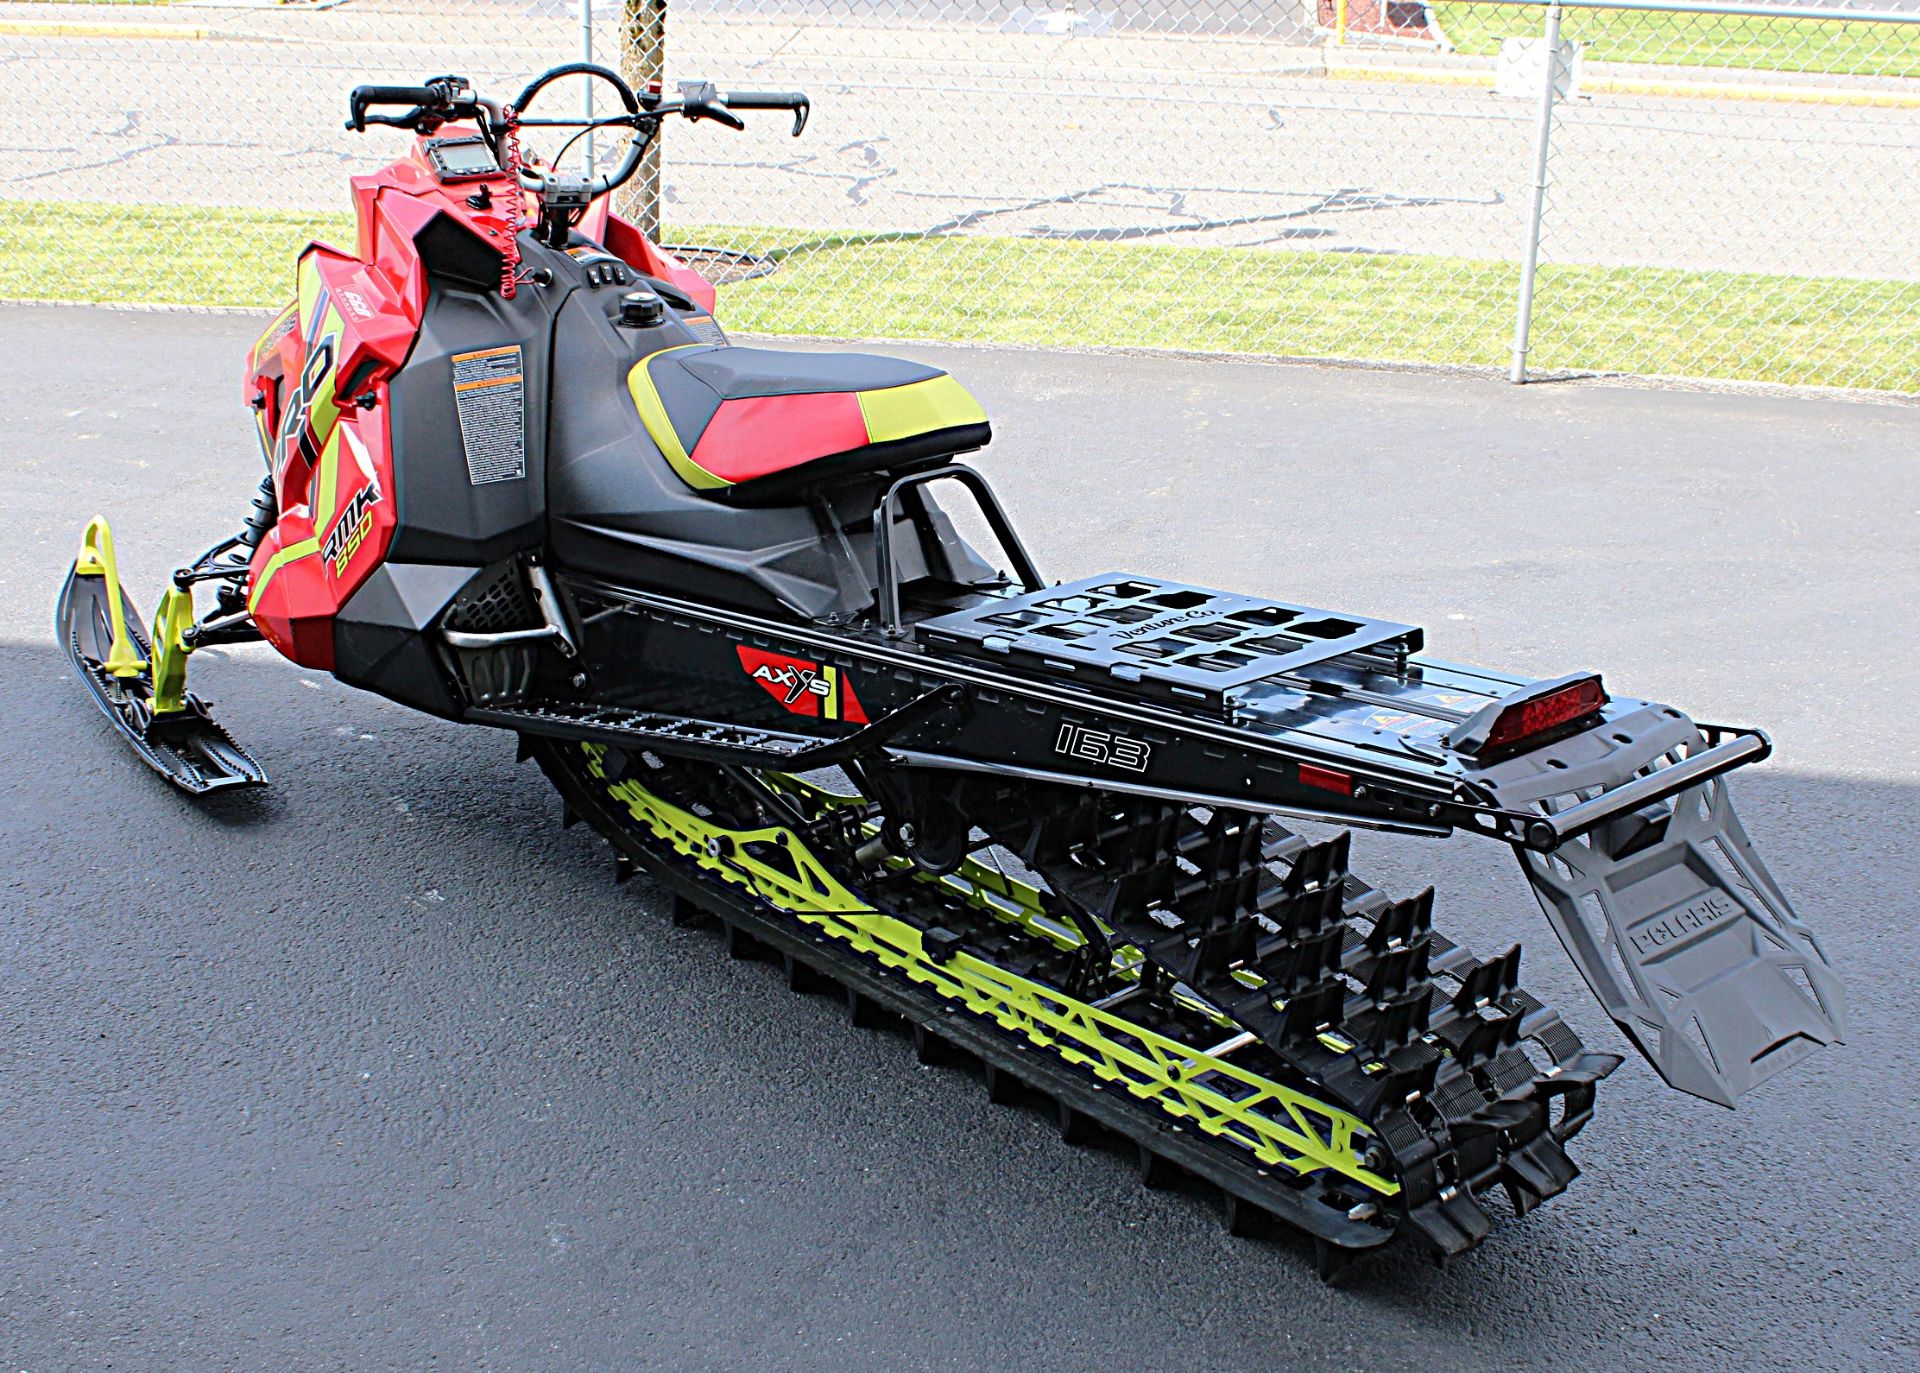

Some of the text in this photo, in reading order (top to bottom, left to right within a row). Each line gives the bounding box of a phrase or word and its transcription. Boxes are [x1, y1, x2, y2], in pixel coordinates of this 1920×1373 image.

[321, 480, 384, 565] RMK
[335, 510, 373, 579] 850
[1109, 616, 1189, 640] Venture
[752, 665, 831, 704] AXYS
[1055, 723, 1151, 773] 163
[1629, 896, 1733, 955] POLARIS
